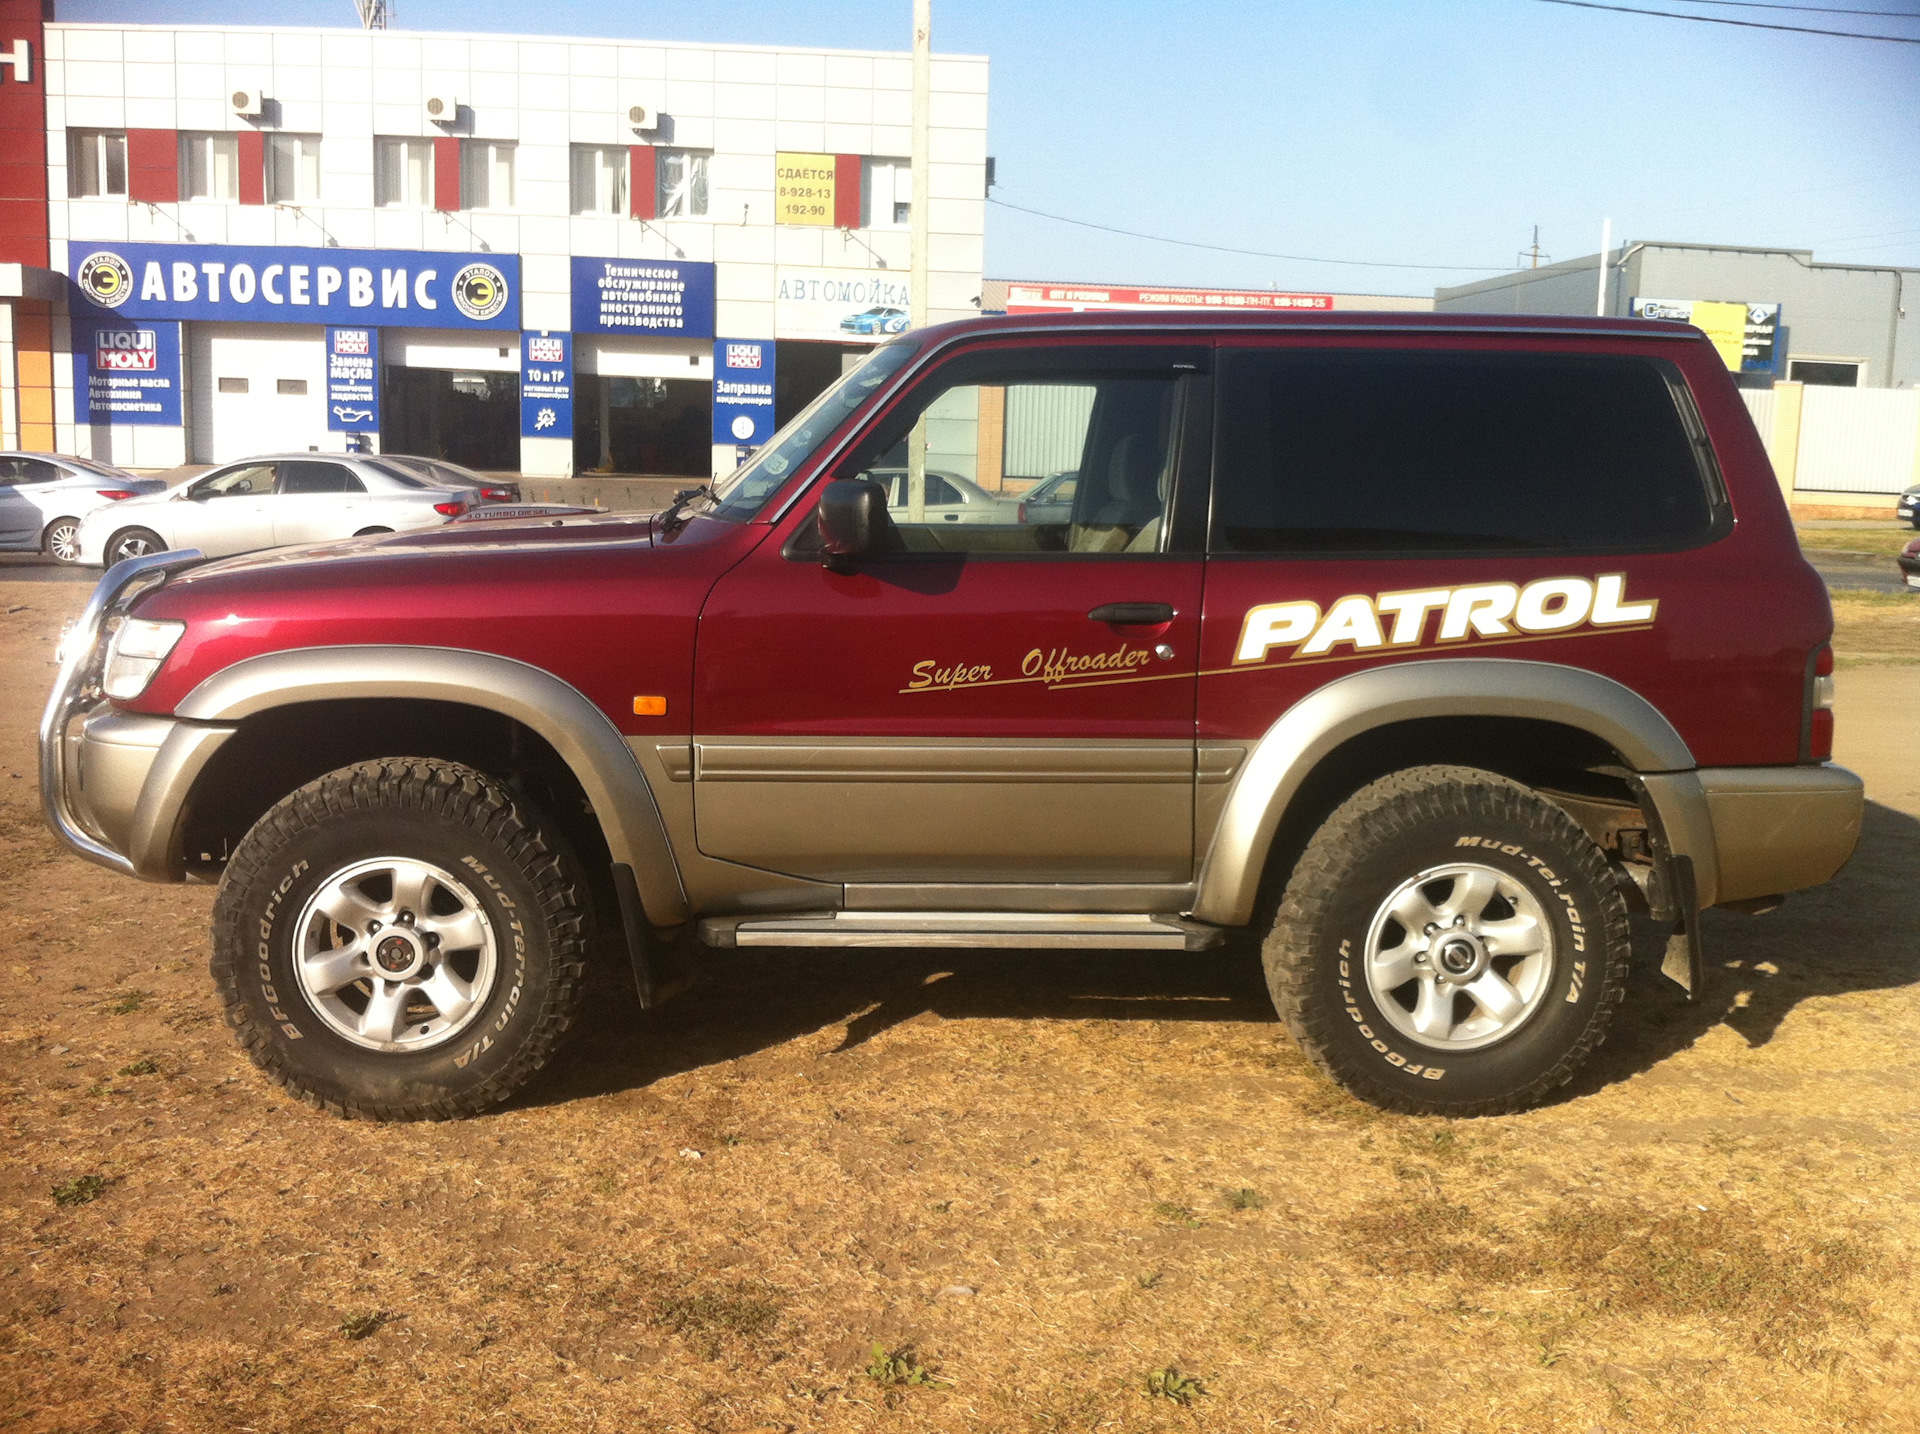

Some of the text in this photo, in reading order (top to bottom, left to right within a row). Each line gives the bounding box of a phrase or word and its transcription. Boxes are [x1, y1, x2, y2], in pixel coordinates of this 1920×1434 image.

[777, 167, 833, 180] СДАЁТСЯ
[779, 187, 831, 199] 8-928-13
[785, 204, 825, 215] 192-90
[604, 263, 679, 280] Техническое
[141, 261, 438, 310] АВТОСЕРВИС
[597, 276, 686, 292] обслуживание
[601, 290, 682, 304] автомобилей
[778, 278, 910, 306] АВТОМОЙКА
[600, 302, 683, 317] иностранного
[599, 315, 684, 330] производства
[99, 331, 153, 350] LIQUI
[336, 331, 367, 342] LIQUI
[336, 342, 368, 353] MOLY
[531, 339, 562, 350] LIQUI
[728, 345, 760, 356] LIQUI
[99, 351, 154, 368] MOLY
[330, 354, 373, 368] Замена
[531, 350, 562, 361] MOLY
[728, 356, 760, 367] MOLY
[330, 367, 373, 380] масла
[527, 369, 565, 383] ТО и ТР
[88, 376, 170, 389] Моторные масла
[716, 380, 772, 397] Заправка
[88, 389, 142, 400] Автохимия
[715, 395, 773, 406] кондиционеров
[88, 399, 162, 412] Автокосметика
[466, 512, 481, 520] 3.0
[483, 510, 516, 518] TURBO
[1231, 571, 1660, 666] PATROL
[908, 642, 1150, 690] Super Offroader
[258, 857, 311, 1041] BFGoodrich
[453, 854, 527, 1070] Mud-Terrain T/A
[1565, 960, 1586, 1004] T/A
[1339, 938, 1446, 1082] BFGoodrich
